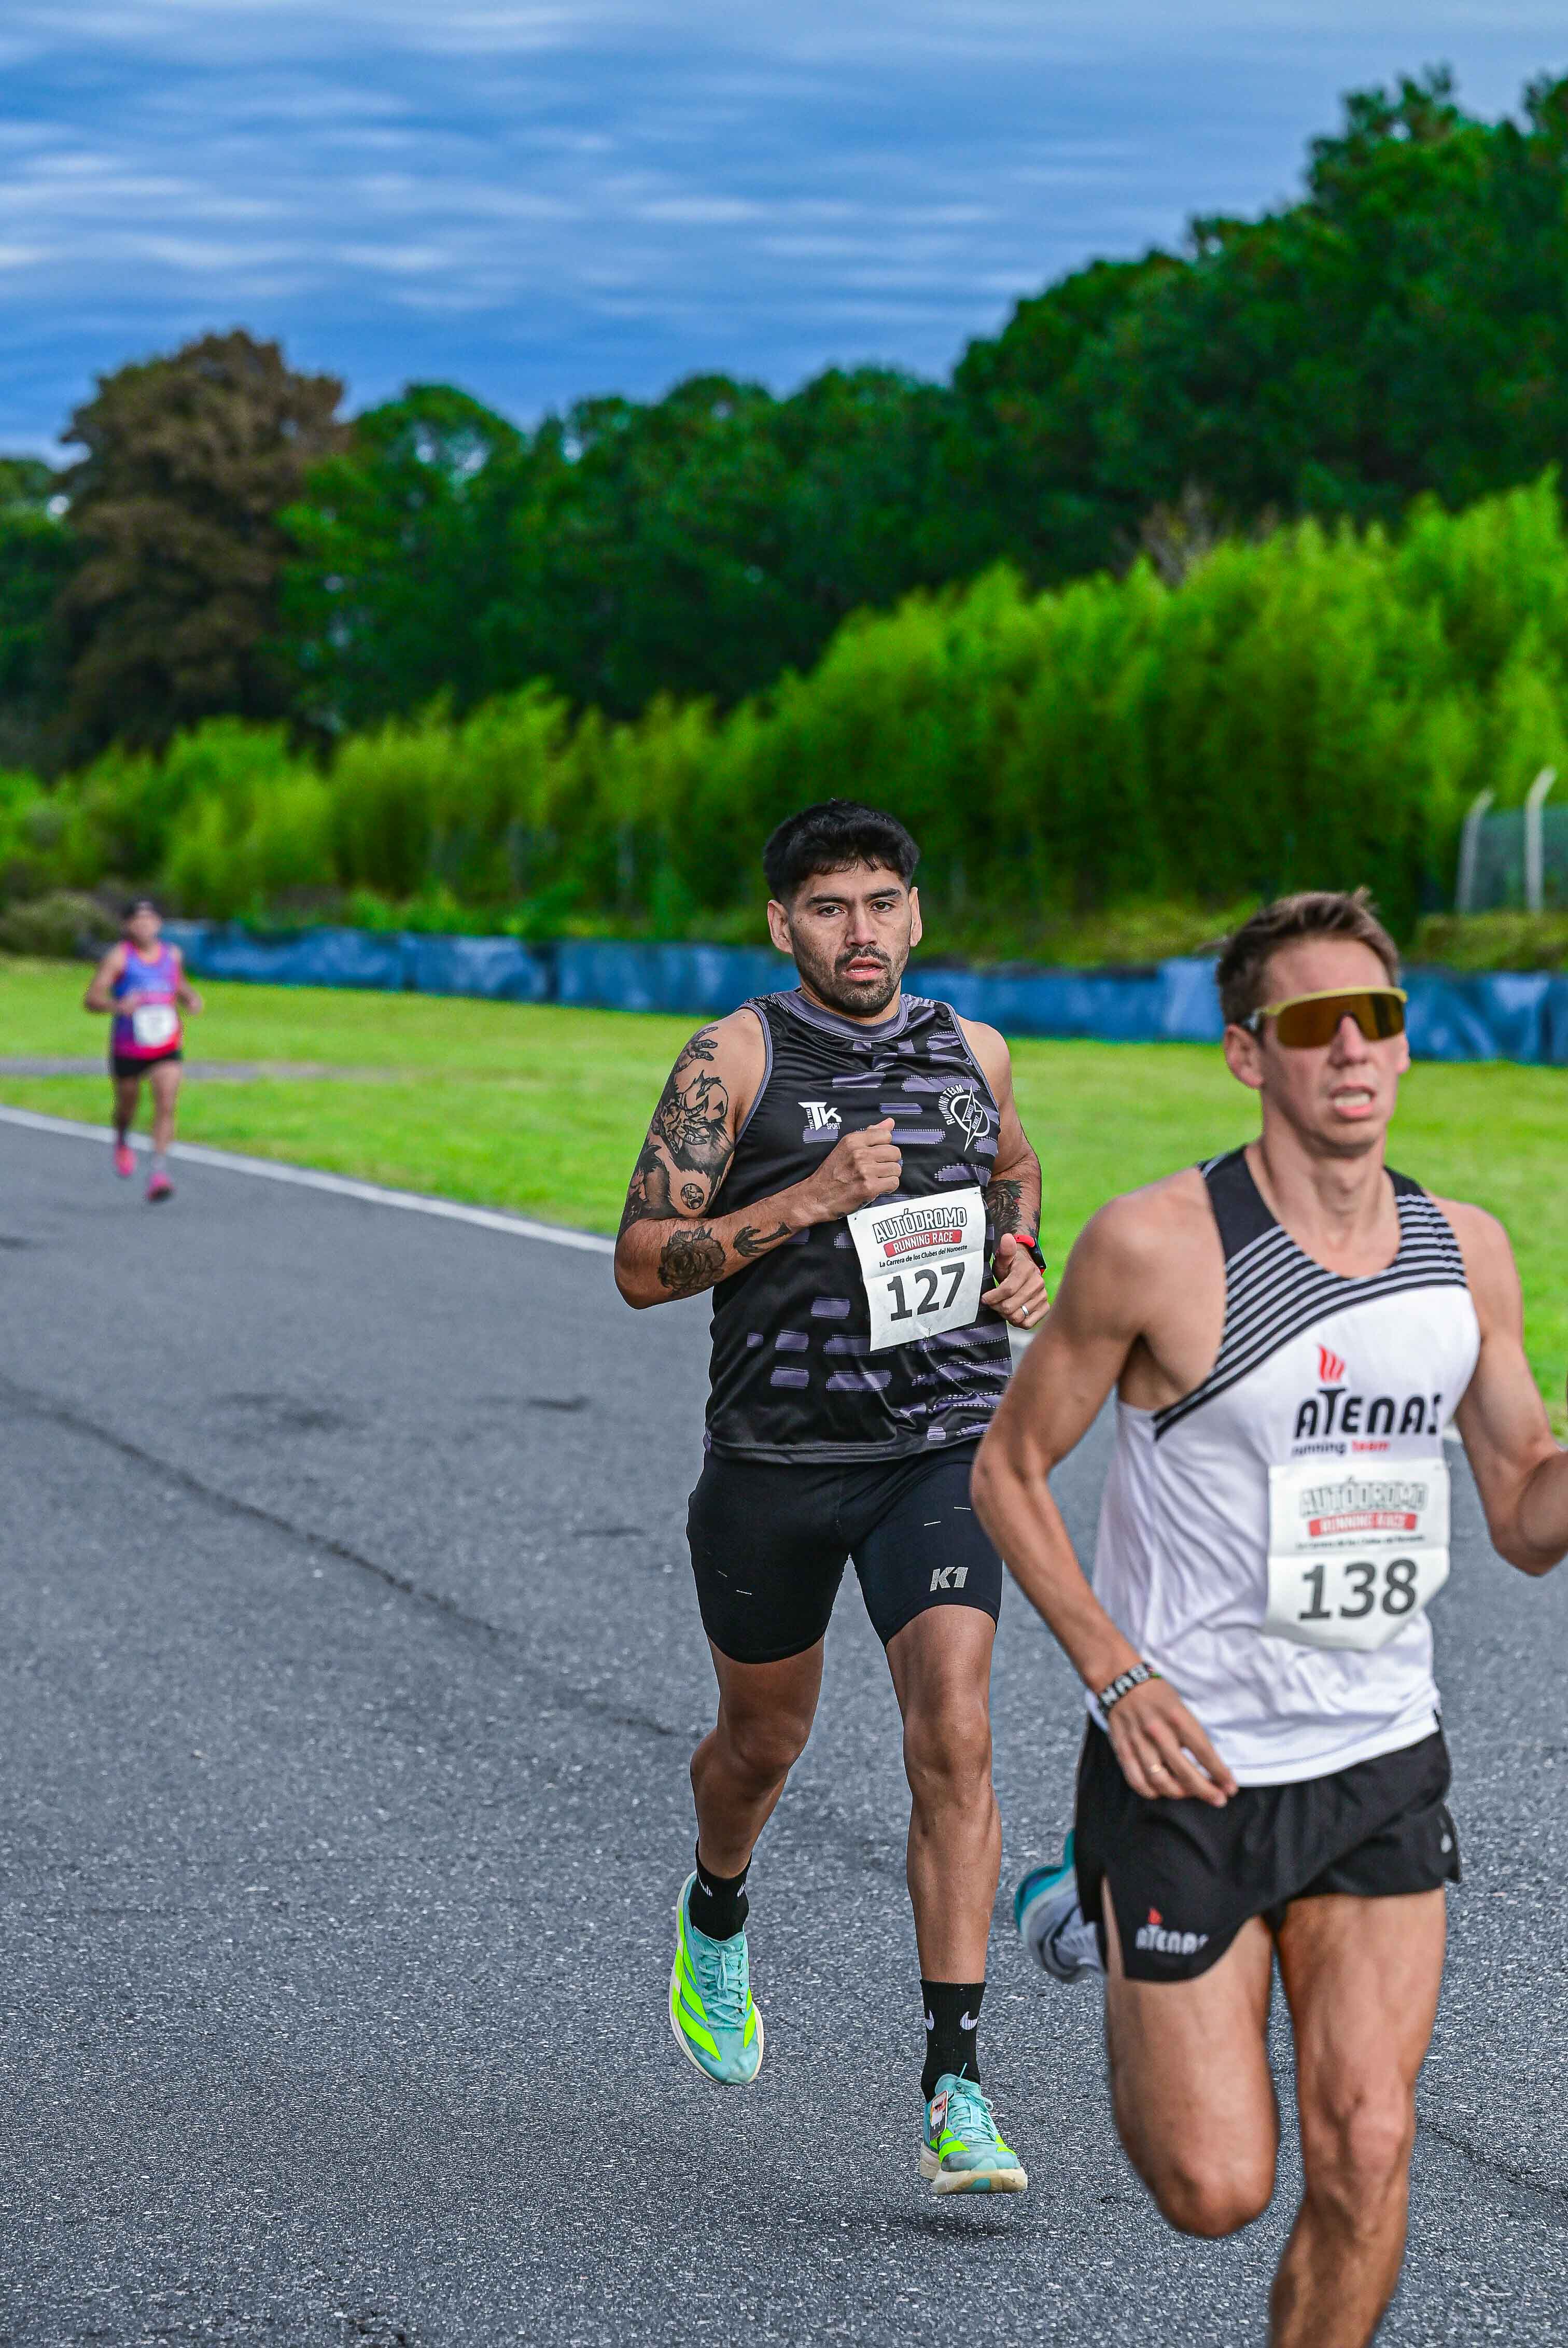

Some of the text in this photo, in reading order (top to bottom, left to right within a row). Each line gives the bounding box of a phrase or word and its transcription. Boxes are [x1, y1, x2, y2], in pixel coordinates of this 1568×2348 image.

[938, 1084, 964, 1125] RUNNING TEAM
[872, 1207, 968, 1243] AUTÓDROMO
[892, 1232, 954, 1253] RUNNING RACE
[886, 1257, 905, 1266] Carrera
[921, 1251, 937, 1259] Clubes
[946, 1245, 968, 1254] Noroeste
[887, 1262, 965, 1321] 127
[930, 1566, 969, 1592] K1
[1298, 1559, 1417, 1620] 138
